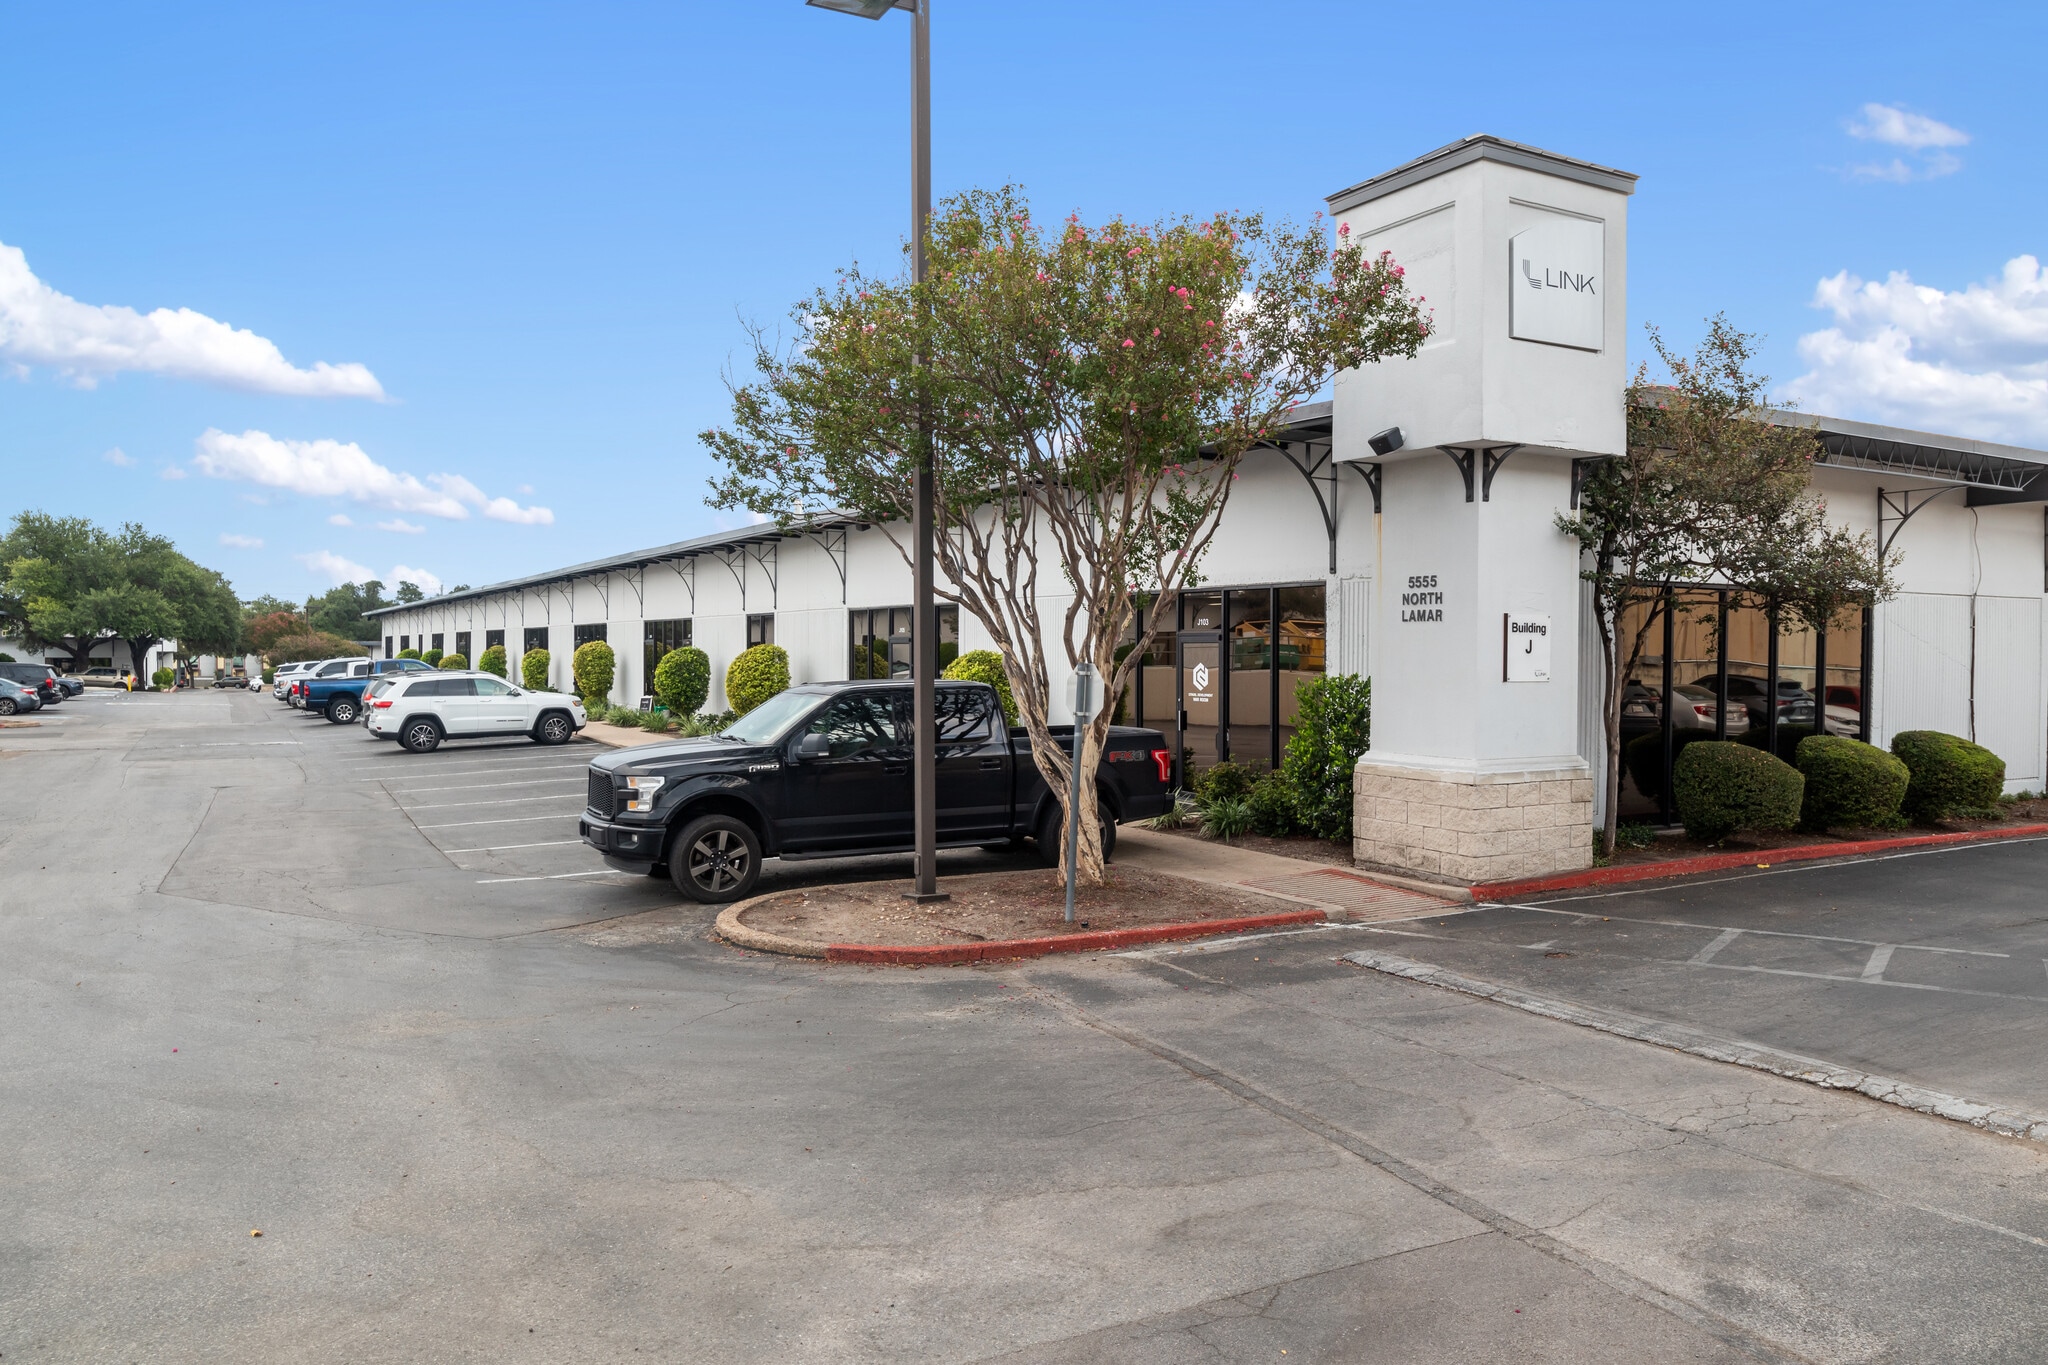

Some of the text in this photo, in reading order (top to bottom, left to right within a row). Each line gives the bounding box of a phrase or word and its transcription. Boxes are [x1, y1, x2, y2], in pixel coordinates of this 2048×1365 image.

[1546, 267, 1596, 295] LINK
[1408, 575, 1438, 588] 5555
[1402, 592, 1443, 605] NORTH
[1402, 609, 1443, 622] LAMAR
[1512, 622, 1547, 636] Building
[1525, 639, 1532, 654] J
